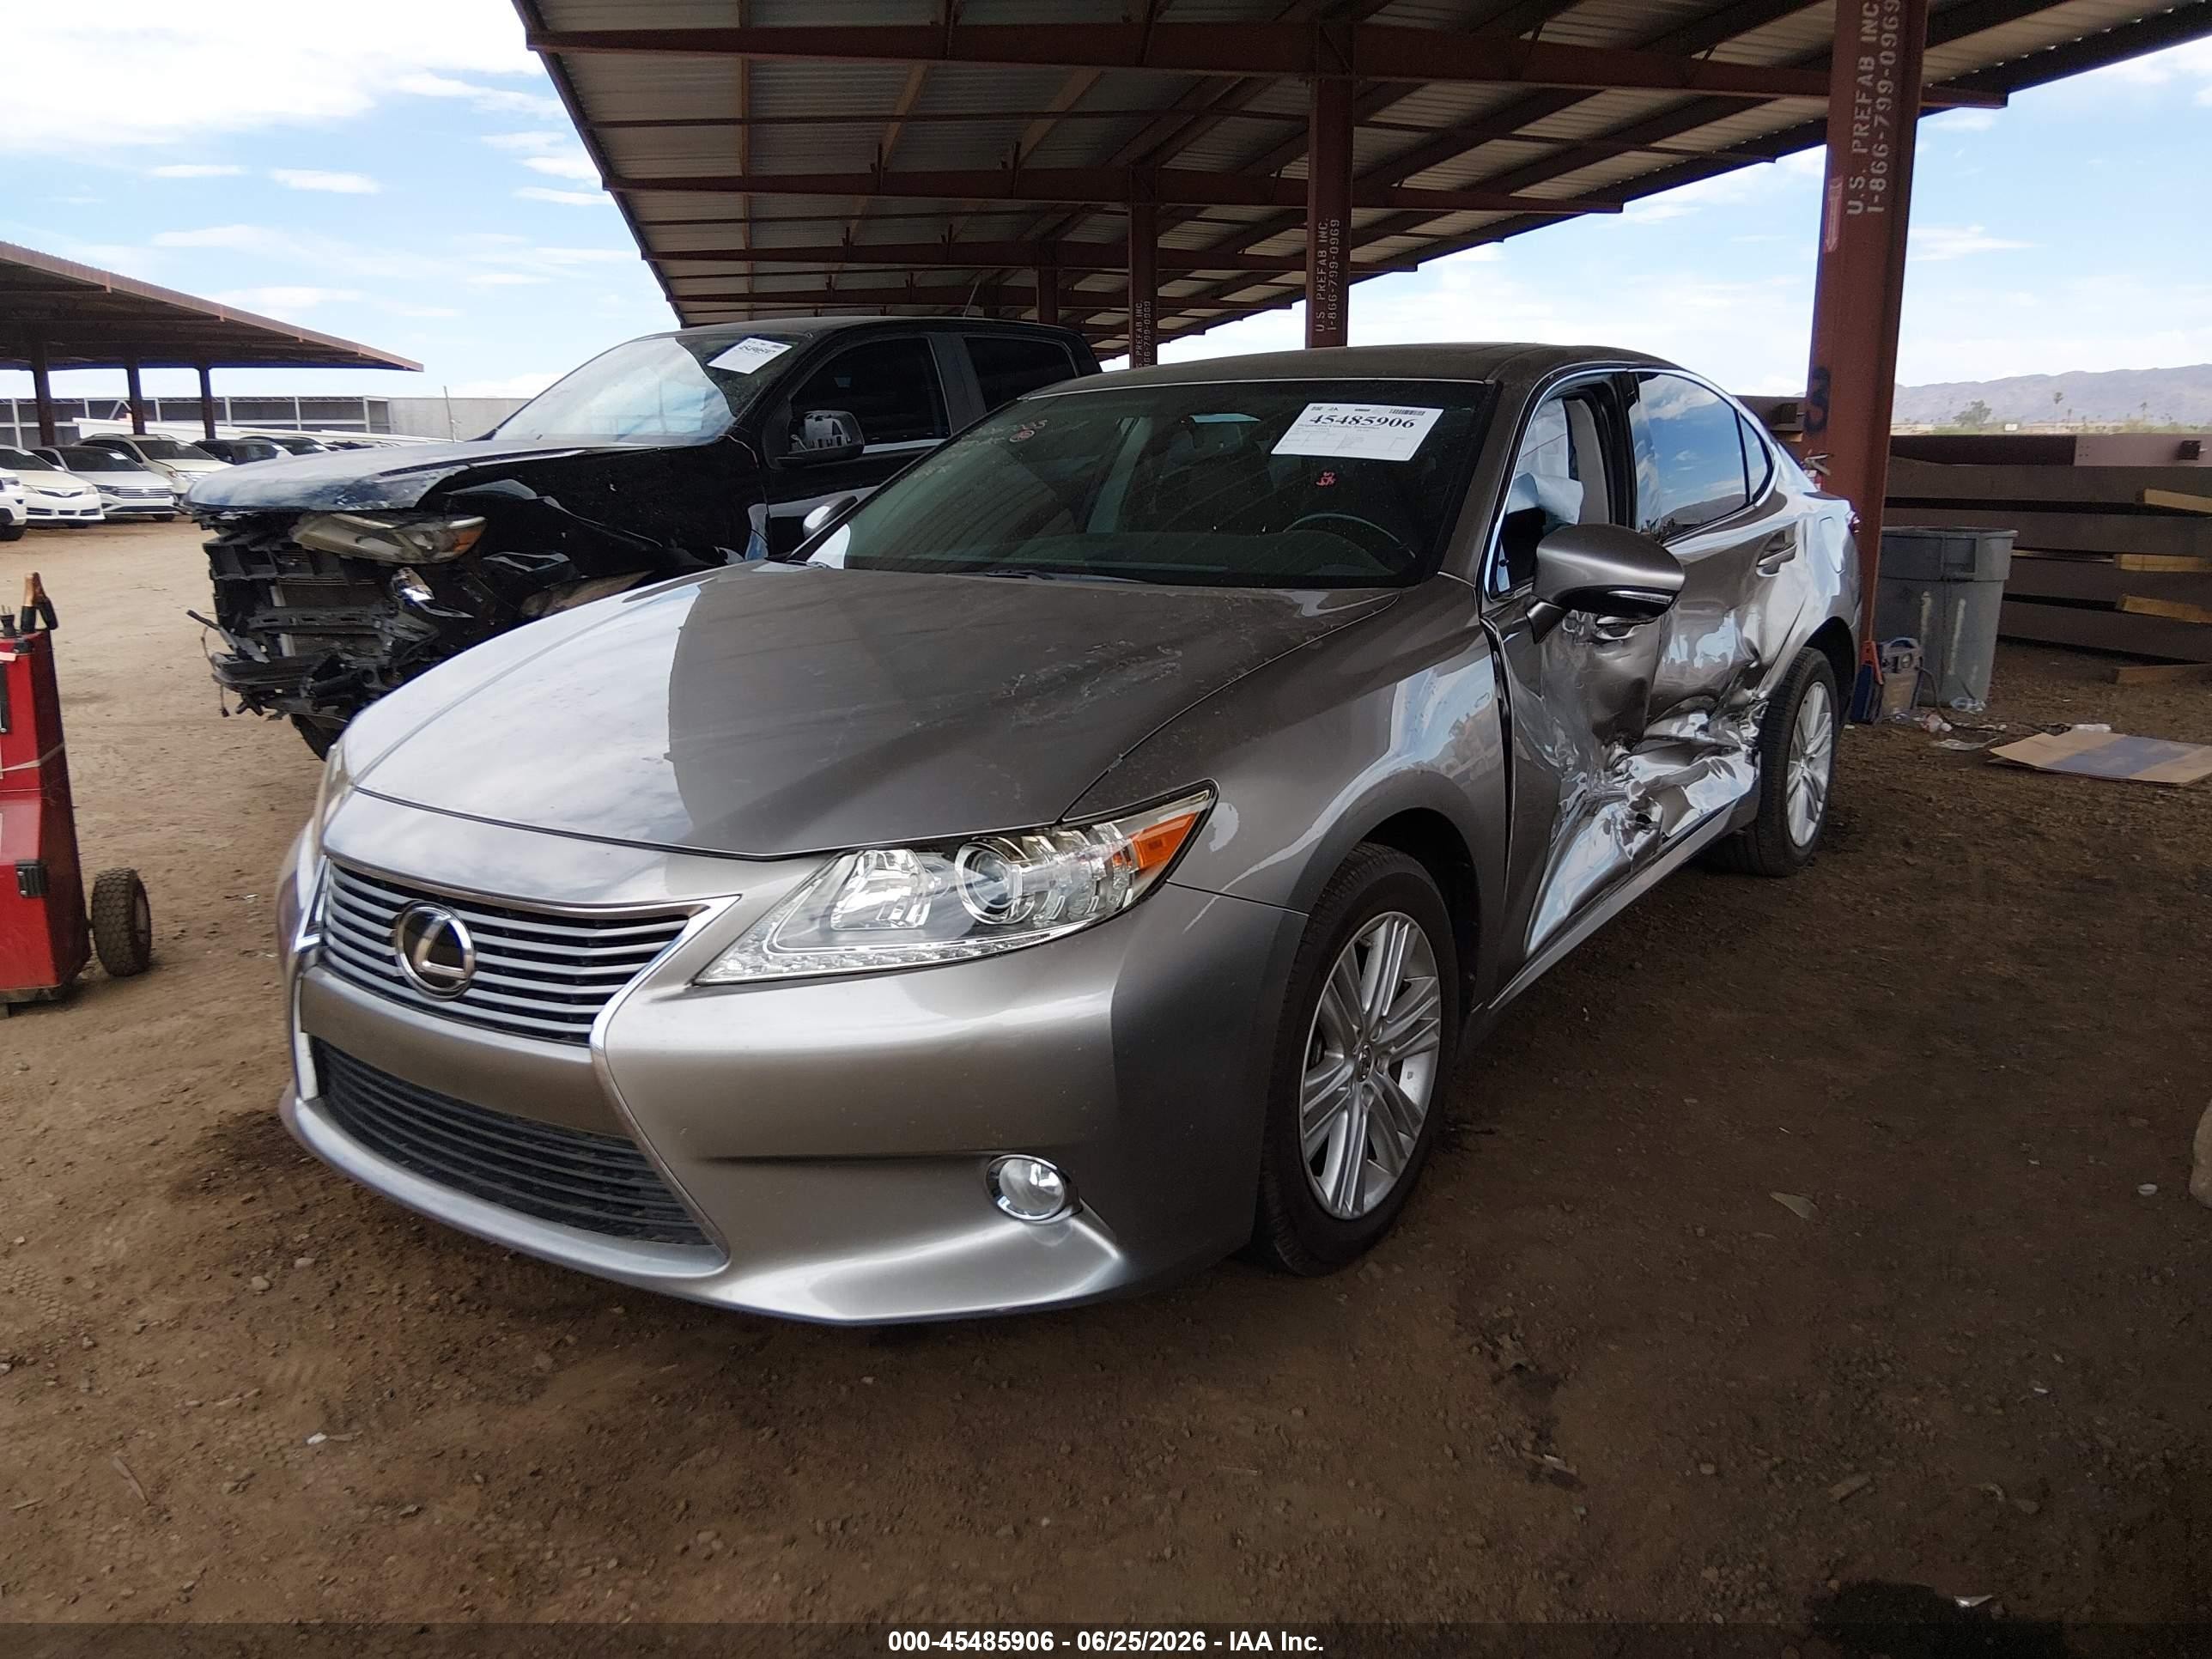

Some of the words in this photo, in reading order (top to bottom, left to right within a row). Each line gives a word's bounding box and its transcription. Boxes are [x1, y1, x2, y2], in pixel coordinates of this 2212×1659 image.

[1851, 56, 1875, 155] PREFAB
[1316, 249, 1328, 301] PREFAB
[1327, 219, 1340, 331] 1-866-799-0969
[1309, 414, 1418, 429] 45485906
